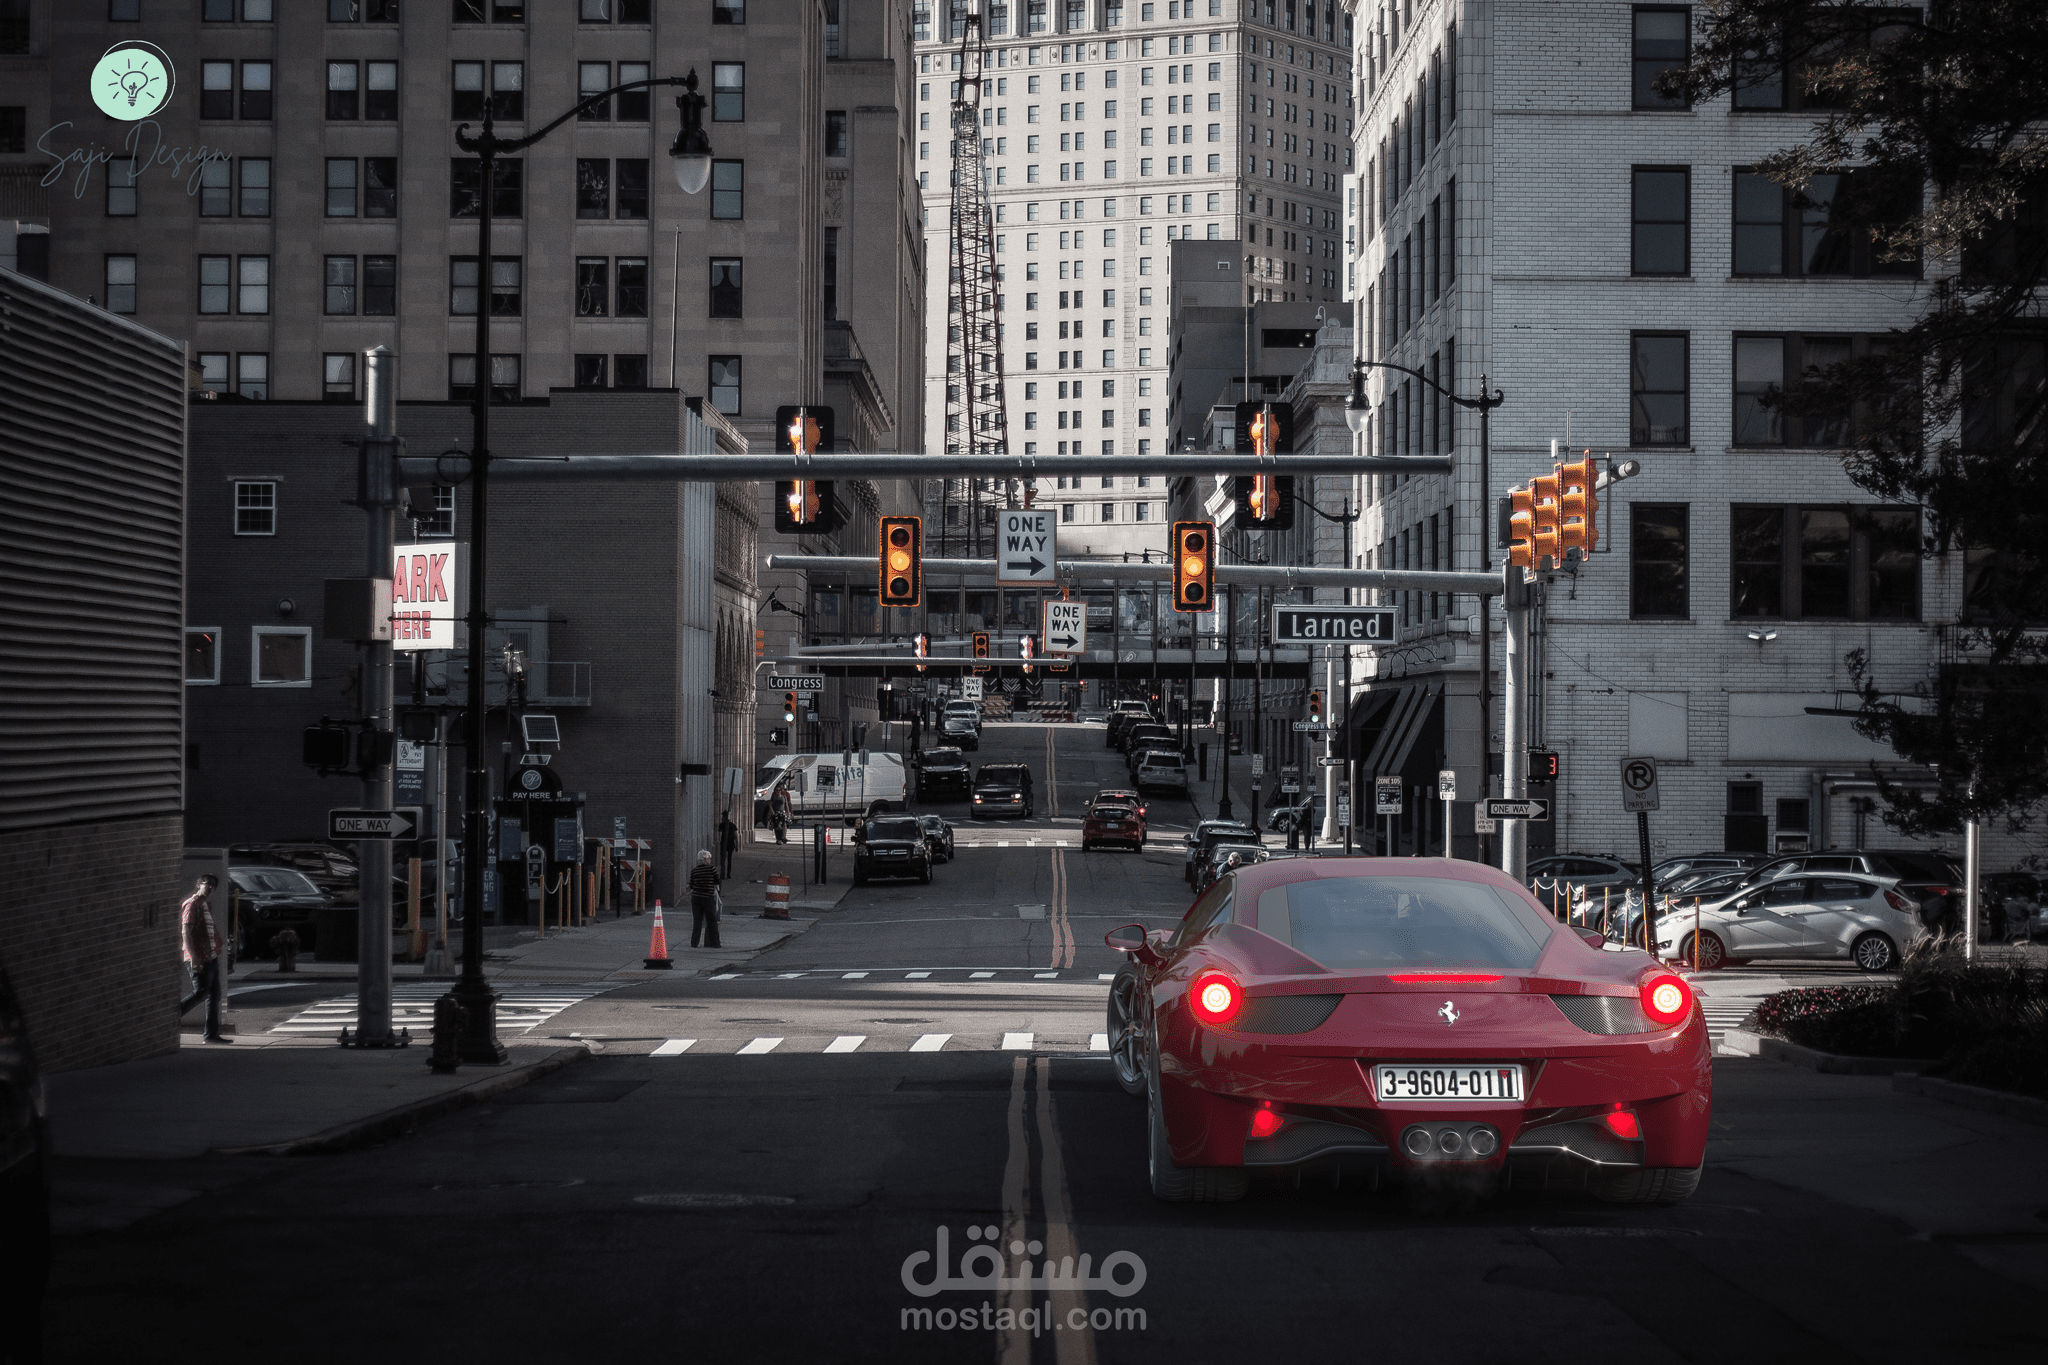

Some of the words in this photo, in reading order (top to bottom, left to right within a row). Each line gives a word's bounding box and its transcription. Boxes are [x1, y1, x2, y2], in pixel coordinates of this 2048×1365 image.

[1008, 516, 1045, 532] ONE
[1007, 536, 1047, 552] WAY
[393, 553, 449, 603] ARK
[1053, 606, 1079, 618] ONE
[393, 611, 431, 639] HERE
[1052, 620, 1080, 632] WAY
[1292, 613, 1380, 638] Larned
[770, 678, 821, 690] Congress
[1549, 756, 1557, 775] 3
[1391, 777, 1400, 785] 105
[1636, 792, 1646, 800] NO
[1493, 805, 1509, 813] ONE
[1512, 805, 1530, 813] WAY
[1628, 800, 1656, 809] PARKING
[338, 819, 362, 831] ONE
[366, 819, 391, 831] WAY
